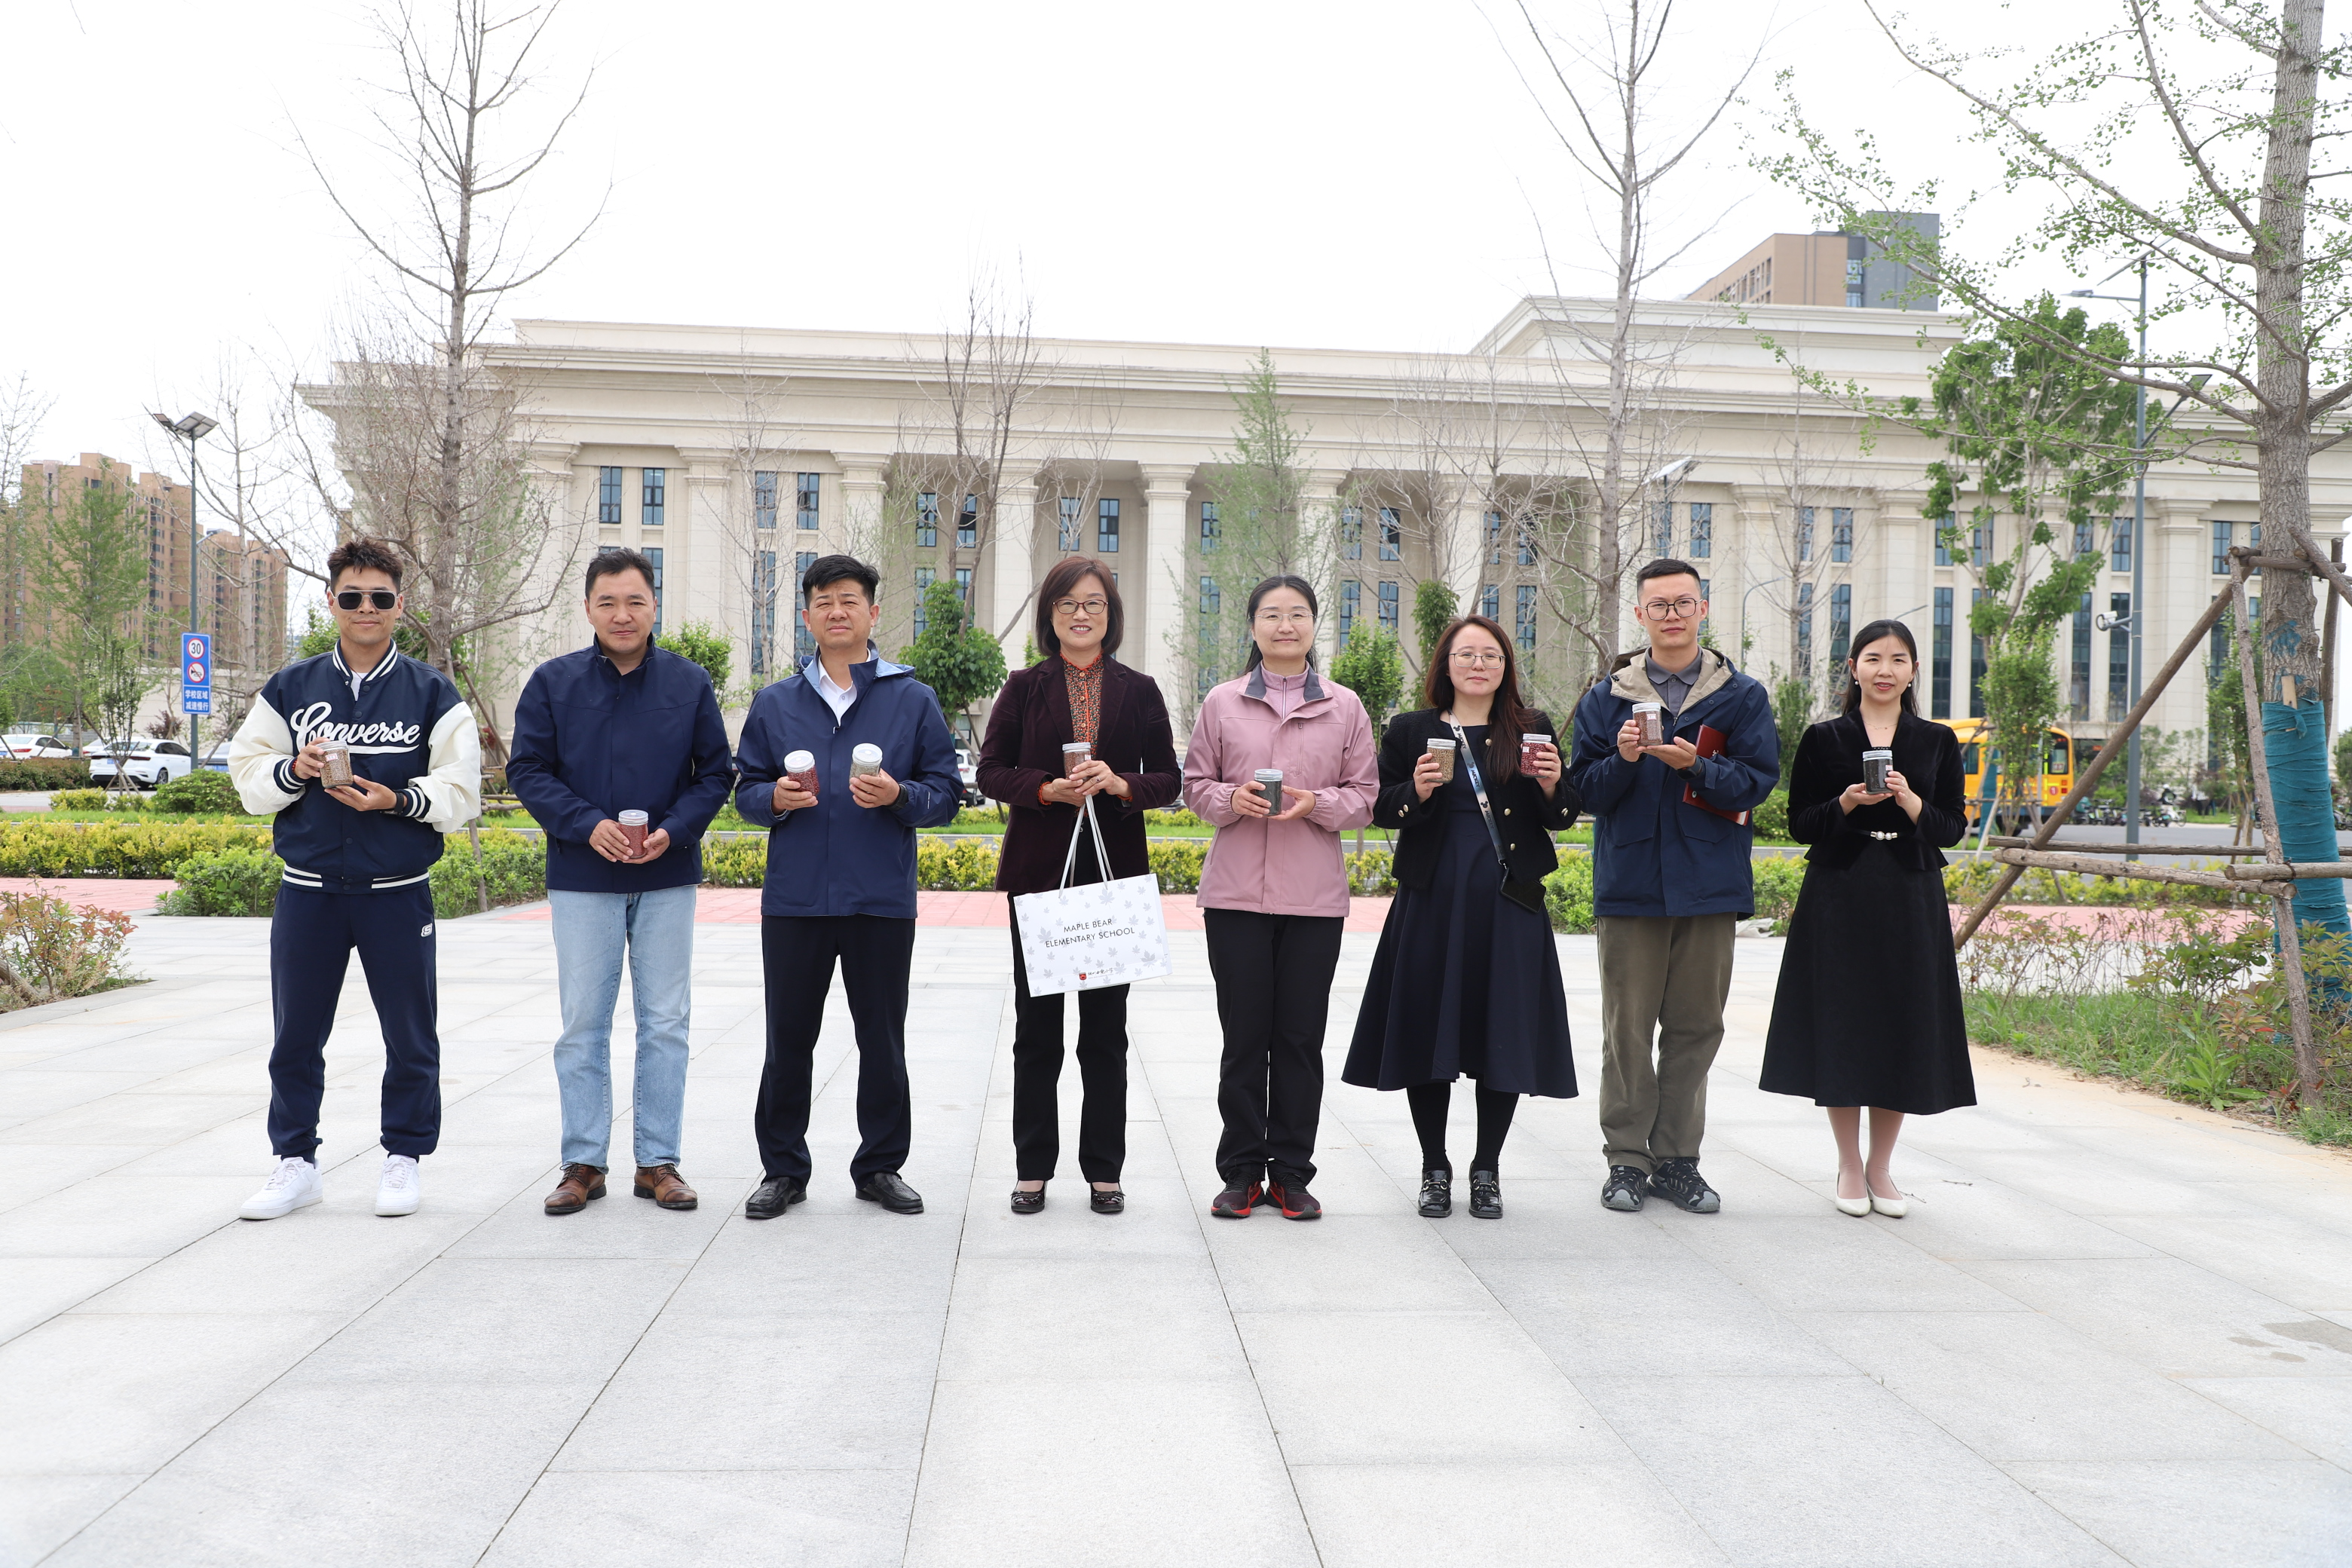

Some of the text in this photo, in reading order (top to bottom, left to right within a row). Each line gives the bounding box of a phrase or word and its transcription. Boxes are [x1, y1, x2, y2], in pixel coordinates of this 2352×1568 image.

[191, 642, 201, 654] 30
[185, 690, 208, 700] 学校区域
[185, 701, 208, 711] 减速慢行
[290, 701, 421, 753] Converse
[1471, 770, 1481, 788] MICKEY
[1485, 810, 1495, 829] MICKEY
[1064, 918, 1113, 933] MAPLE BEAR
[1046, 927, 1135, 948] ELEMENTARY SCHOOL
